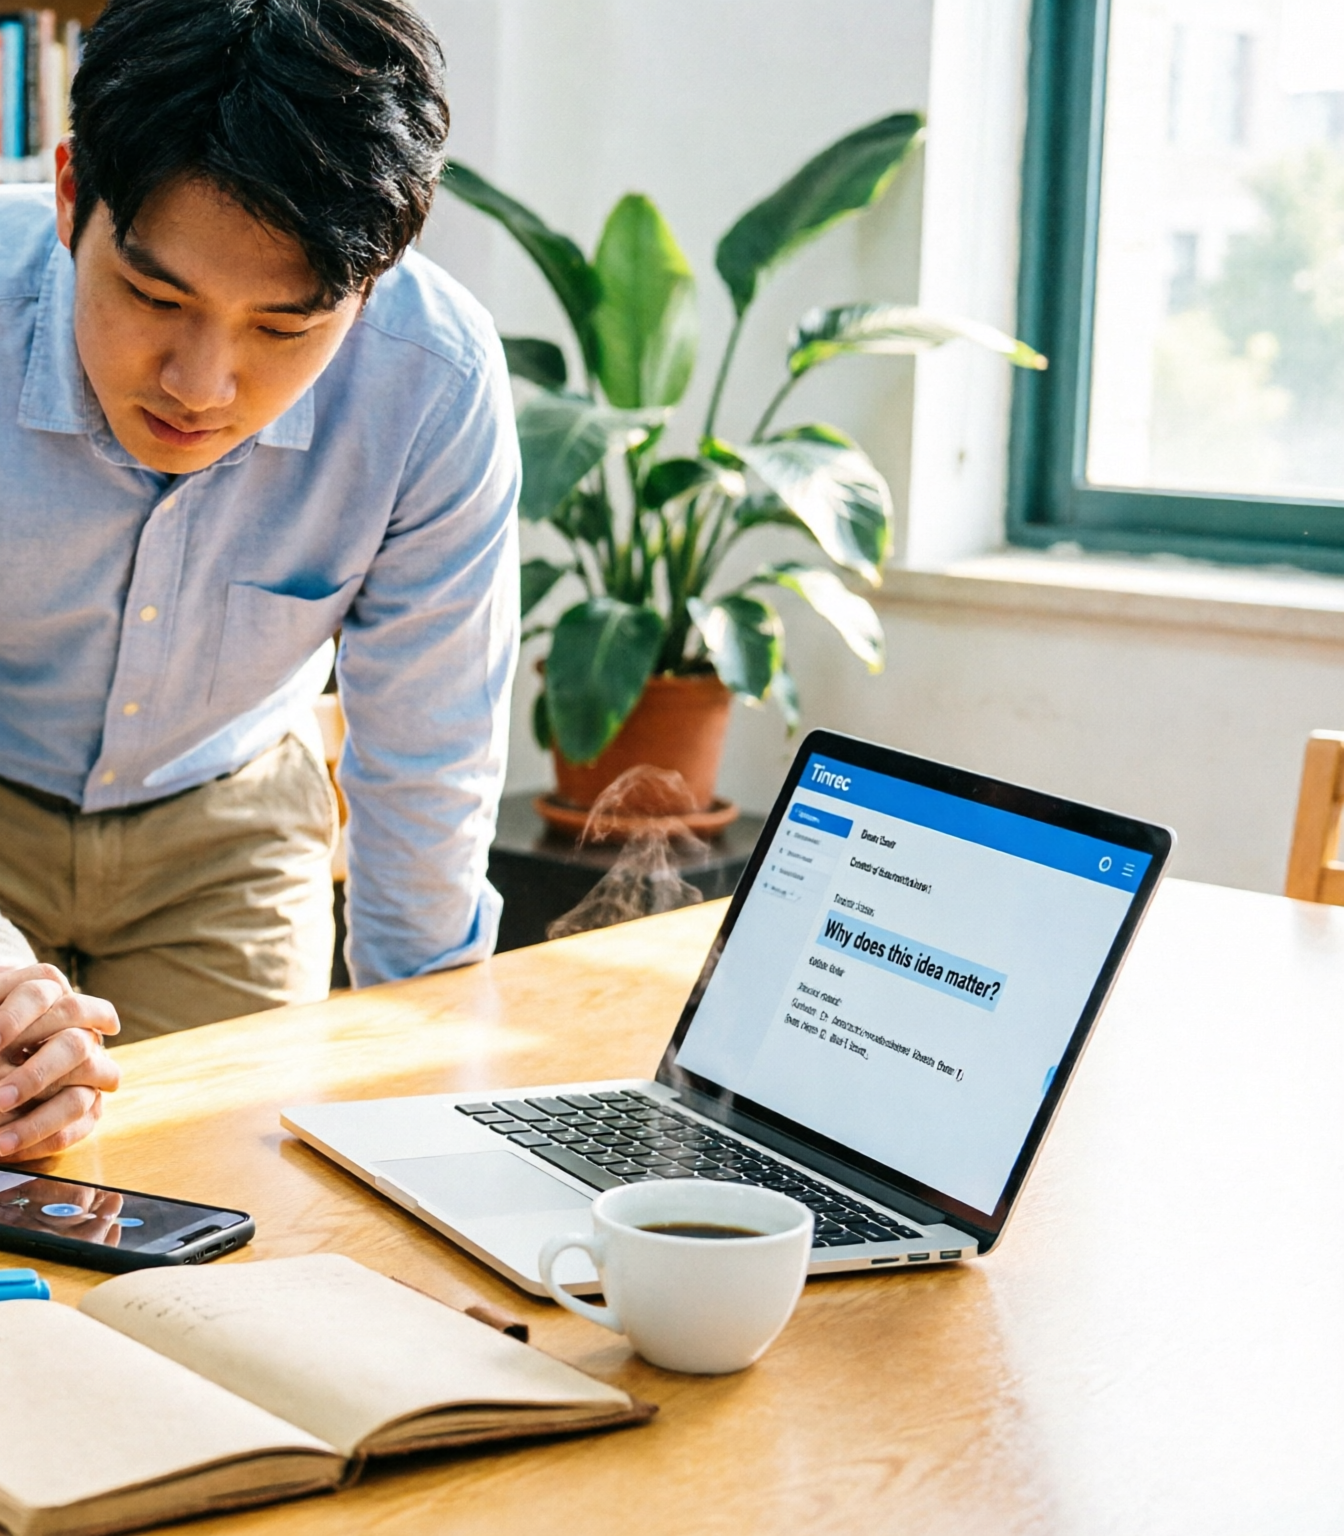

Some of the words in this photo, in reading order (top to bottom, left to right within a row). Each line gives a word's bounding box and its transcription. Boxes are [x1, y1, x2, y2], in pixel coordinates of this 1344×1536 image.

[811, 763, 852, 791] Tinrec
[824, 918, 853, 948] Why
[853, 931, 887, 958] does
[888, 944, 913, 968] this
[914, 953, 943, 980] idea
[945, 969, 1001, 1001] matter?
